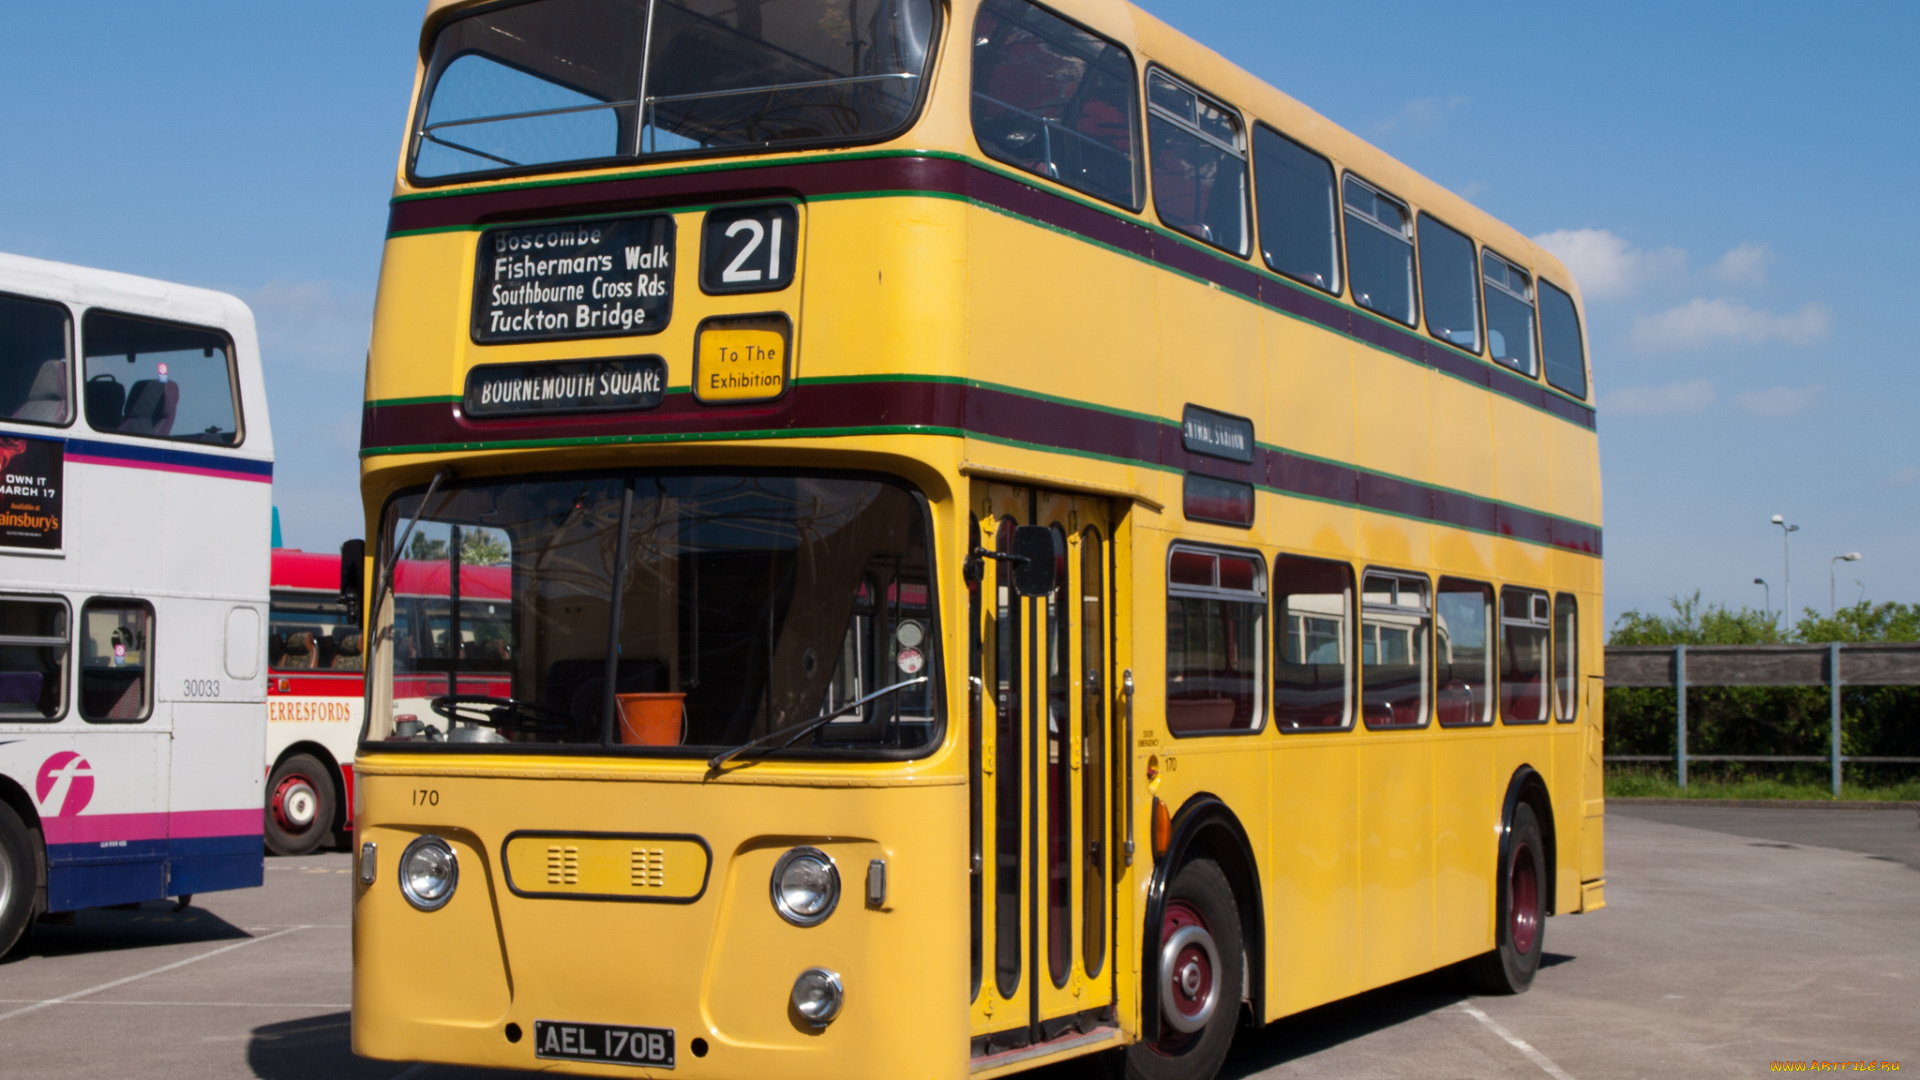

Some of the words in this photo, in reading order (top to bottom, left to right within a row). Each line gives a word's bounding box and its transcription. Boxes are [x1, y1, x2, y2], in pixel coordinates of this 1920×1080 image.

[495, 228, 602, 252] Boscombe
[722, 218, 782, 282] 21
[495, 254, 613, 281] Fisherman's
[625, 245, 669, 270] Walk
[492, 280, 584, 306] Southbourne
[592, 276, 633, 299] Cross
[490, 308, 568, 332] Tuckton
[576, 302, 646, 330] Bridge
[719, 347, 738, 362] To
[745, 345, 776, 361] The
[481, 375, 596, 404] BOURNEMOUTH
[600, 367, 662, 396] SQUARE
[711, 371, 781, 389] Exhibition
[6, 474, 33, 485] OWN
[37, 477, 47, 486] IT
[0, 485, 39, 497] MARCH
[43, 489, 55, 498] 17
[183, 679, 220, 697] 30033
[267, 702, 350, 722] ERRESFORDS
[1165, 757, 1177, 772] 170
[412, 789, 440, 806] 170
[544, 1026, 597, 1055] AEL
[604, 1029, 666, 1060] 170B
